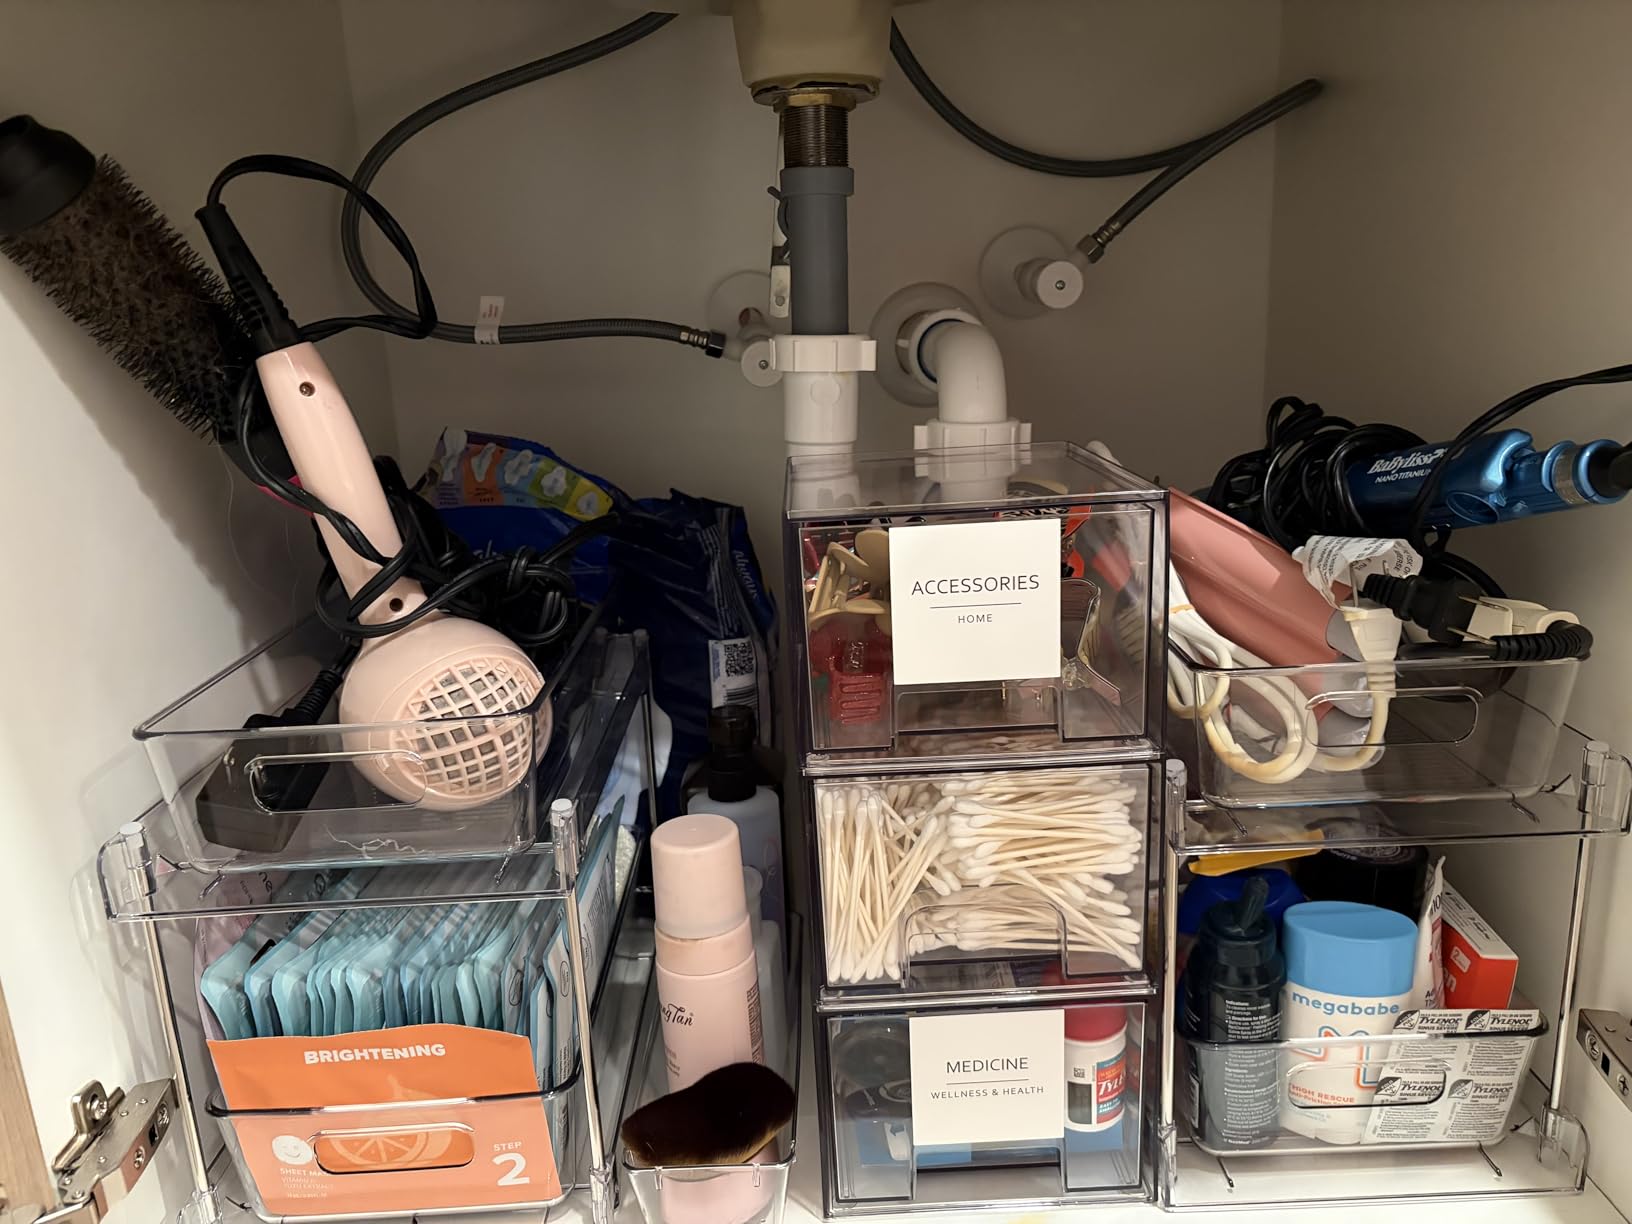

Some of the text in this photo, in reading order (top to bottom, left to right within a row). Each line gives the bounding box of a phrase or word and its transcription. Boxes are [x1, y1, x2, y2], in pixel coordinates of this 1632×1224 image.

[1375, 474, 1398, 484] NANO
[911, 575, 1040, 596] ACCESSORIES
[958, 614, 993, 624] HOME
[1292, 991, 1400, 1016] megababe
[1490, 1017, 1533, 1025] TYLENOL
[304, 1044, 446, 1065] BRIGHTENING
[946, 1057, 1029, 1073] MEDICINE
[931, 1086, 1044, 1100] WELLNESS & HEALTH
[1317, 1092, 1356, 1103] RESCUE
[494, 1141, 522, 1152] STEP
[492, 1152, 530, 1186] 2
